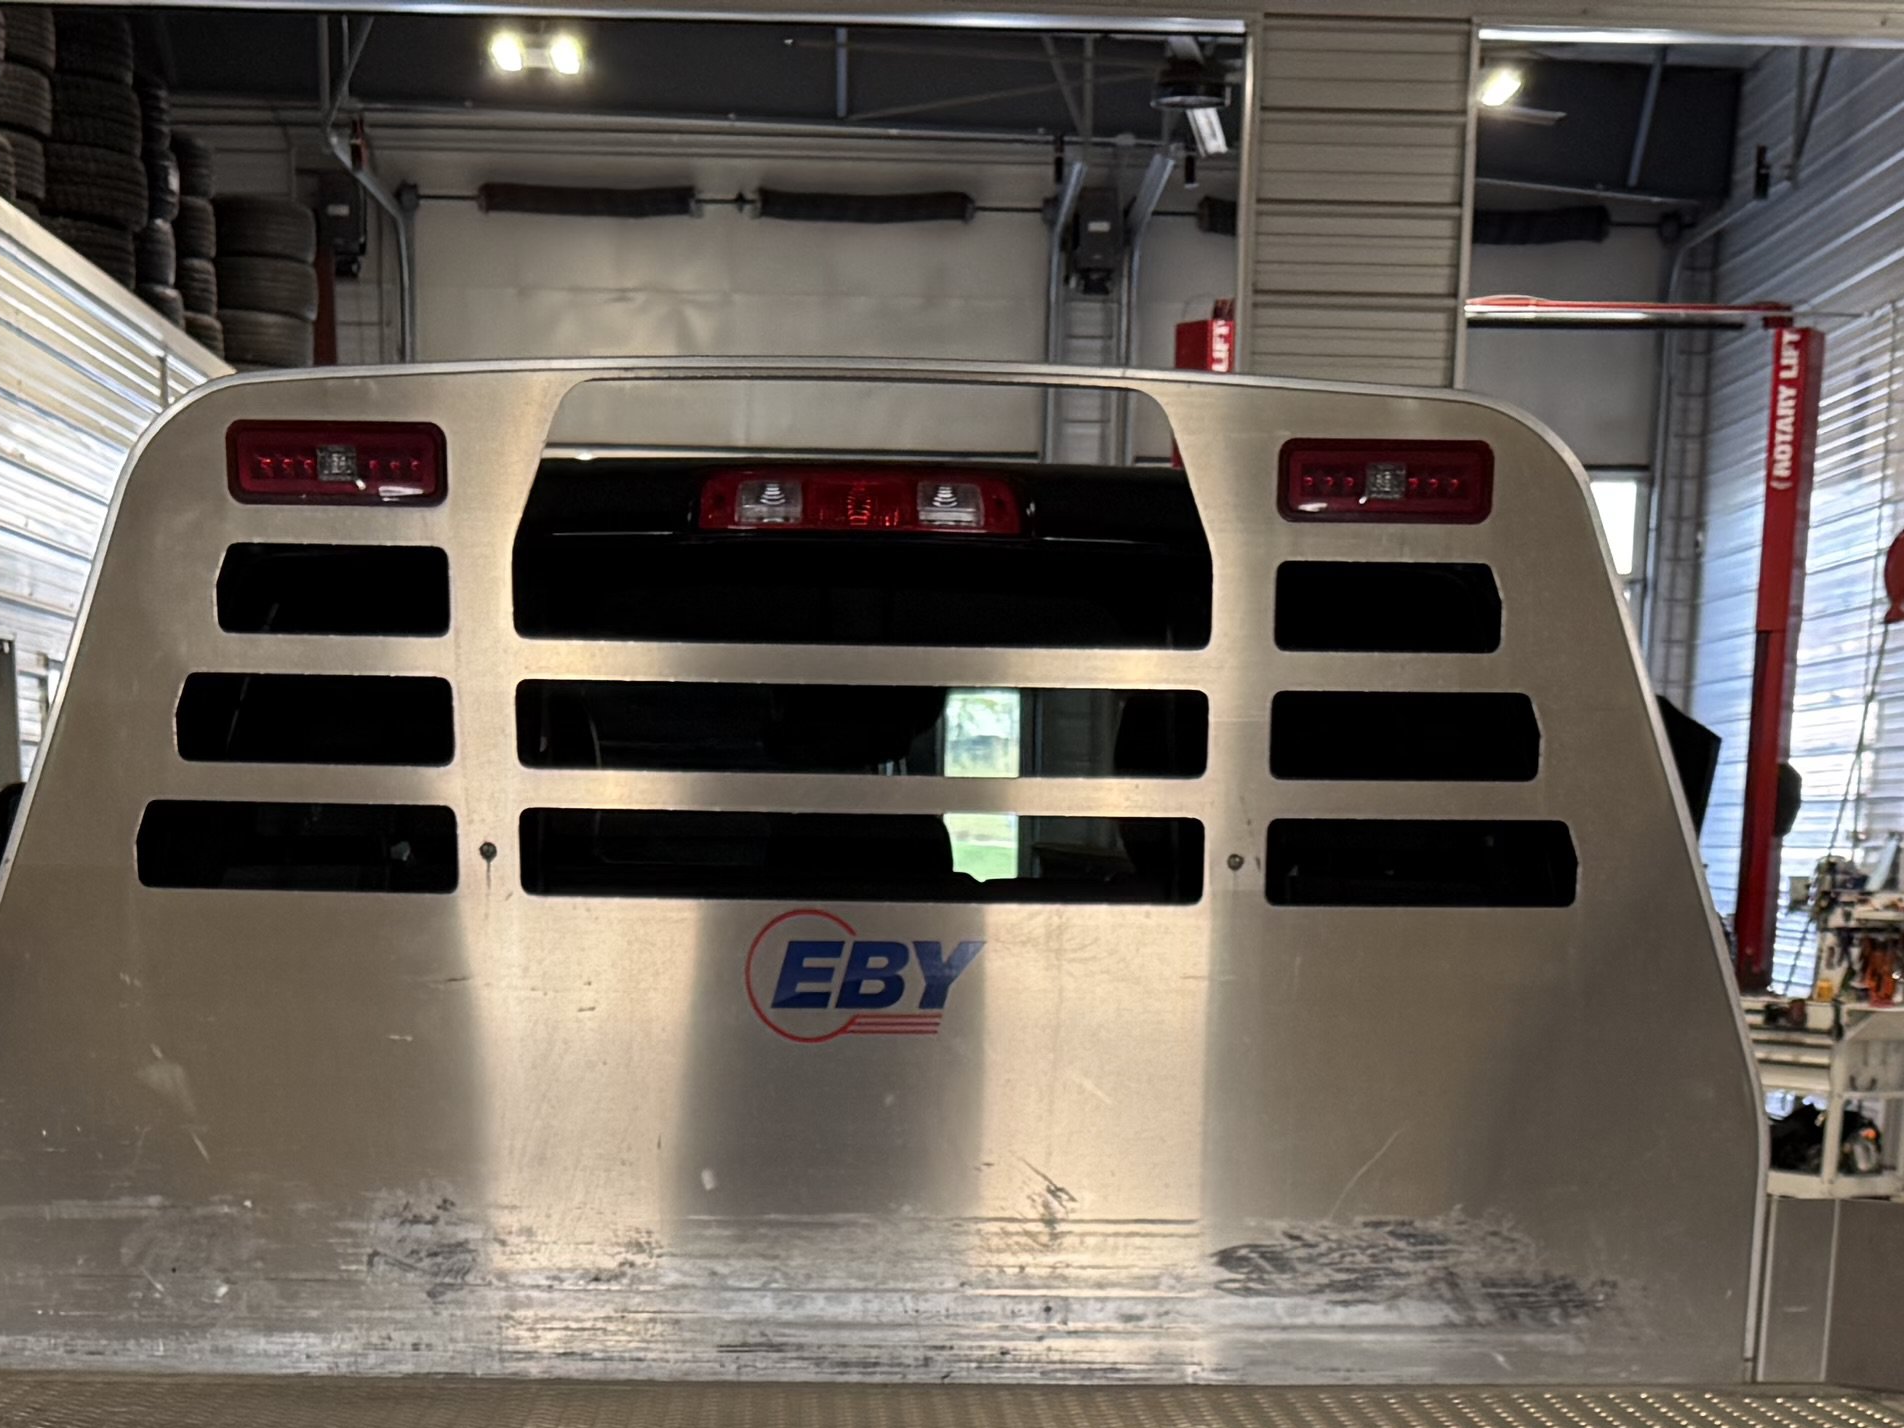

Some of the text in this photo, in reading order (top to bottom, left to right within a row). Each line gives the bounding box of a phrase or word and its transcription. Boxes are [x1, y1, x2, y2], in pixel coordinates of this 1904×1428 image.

[1211, 319, 1230, 372] LIFT
[1771, 329, 1801, 478] ROTARY LIFT
[770, 940, 986, 1010] EBY
